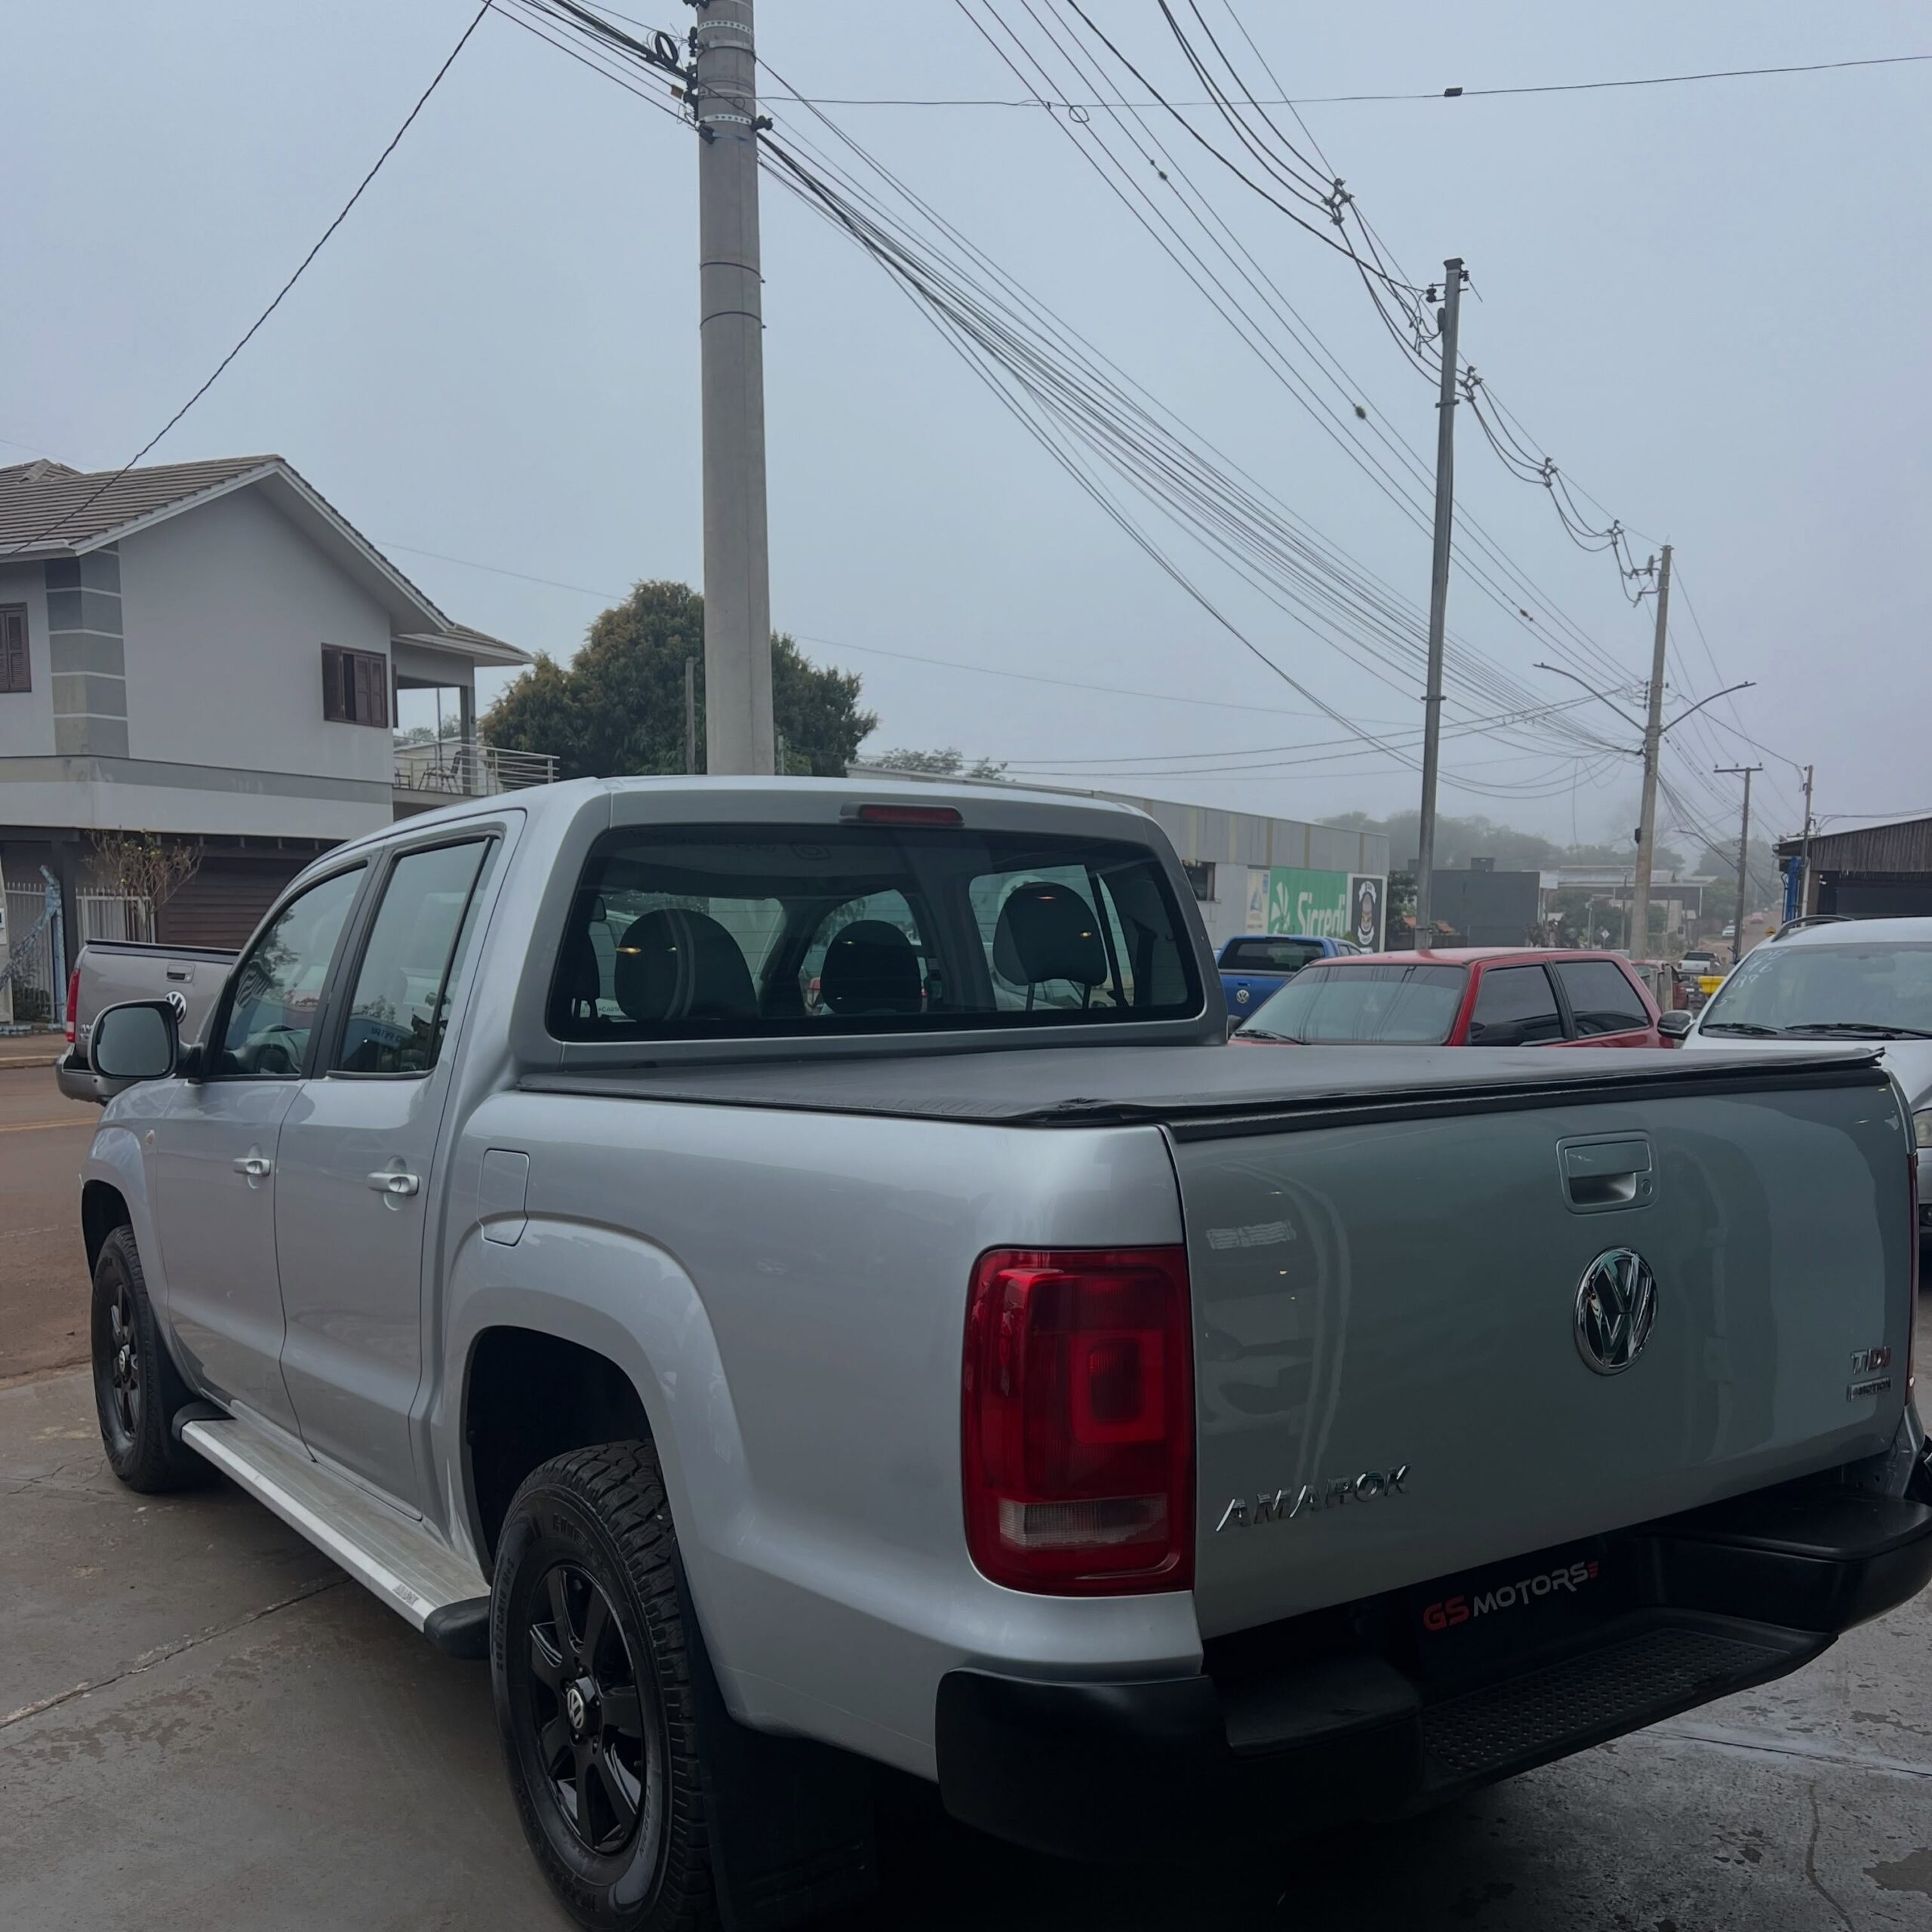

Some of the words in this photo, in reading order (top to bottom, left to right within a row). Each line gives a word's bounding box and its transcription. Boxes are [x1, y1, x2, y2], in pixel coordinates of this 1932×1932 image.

[1850, 1346, 1891, 1374] TDI
[1215, 1463, 1411, 1532] AMAROK
[1423, 1595, 1470, 1631] GS
[1473, 1561, 1589, 1617] MOTORS
